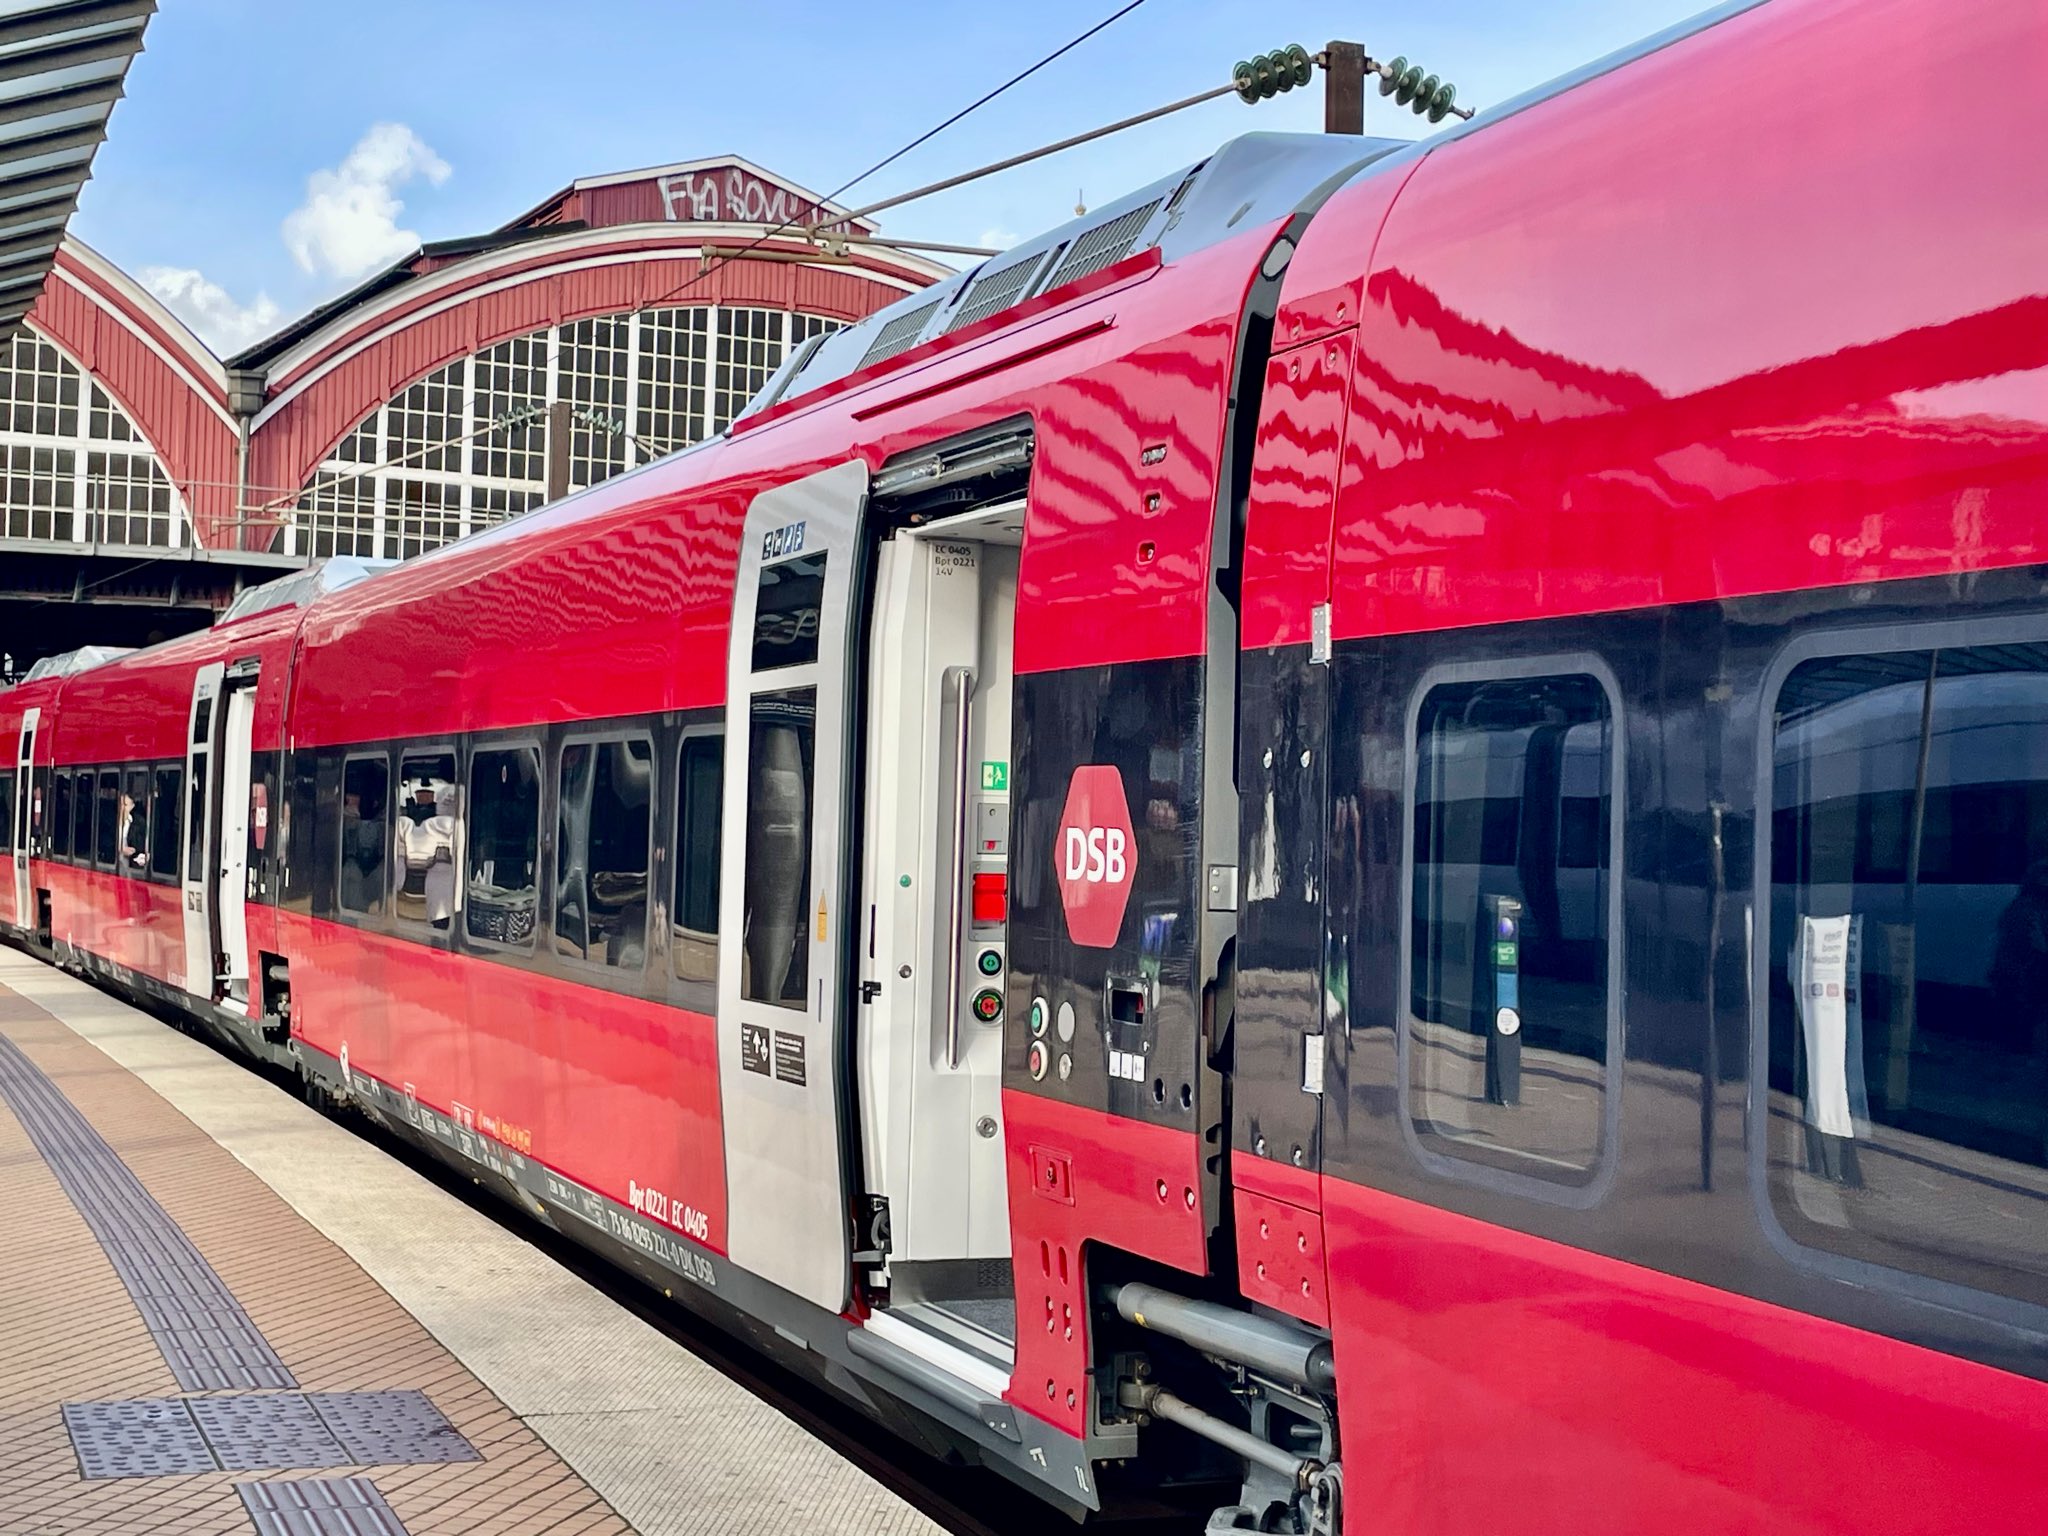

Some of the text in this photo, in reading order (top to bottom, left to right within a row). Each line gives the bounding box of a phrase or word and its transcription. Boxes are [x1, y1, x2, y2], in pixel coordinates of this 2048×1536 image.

[935, 545, 971, 556] EC 0405
[935, 556, 975, 567] Bpt 0221
[1065, 827, 1126, 883] DSB
[629, 1179, 646, 1213] Bpt
[645, 1187, 668, 1222] 0221
[671, 1199, 684, 1230] EC
[684, 1205, 709, 1242] 0405
[678, 1245, 697, 1277] DK
[694, 1253, 717, 1286] DSB
